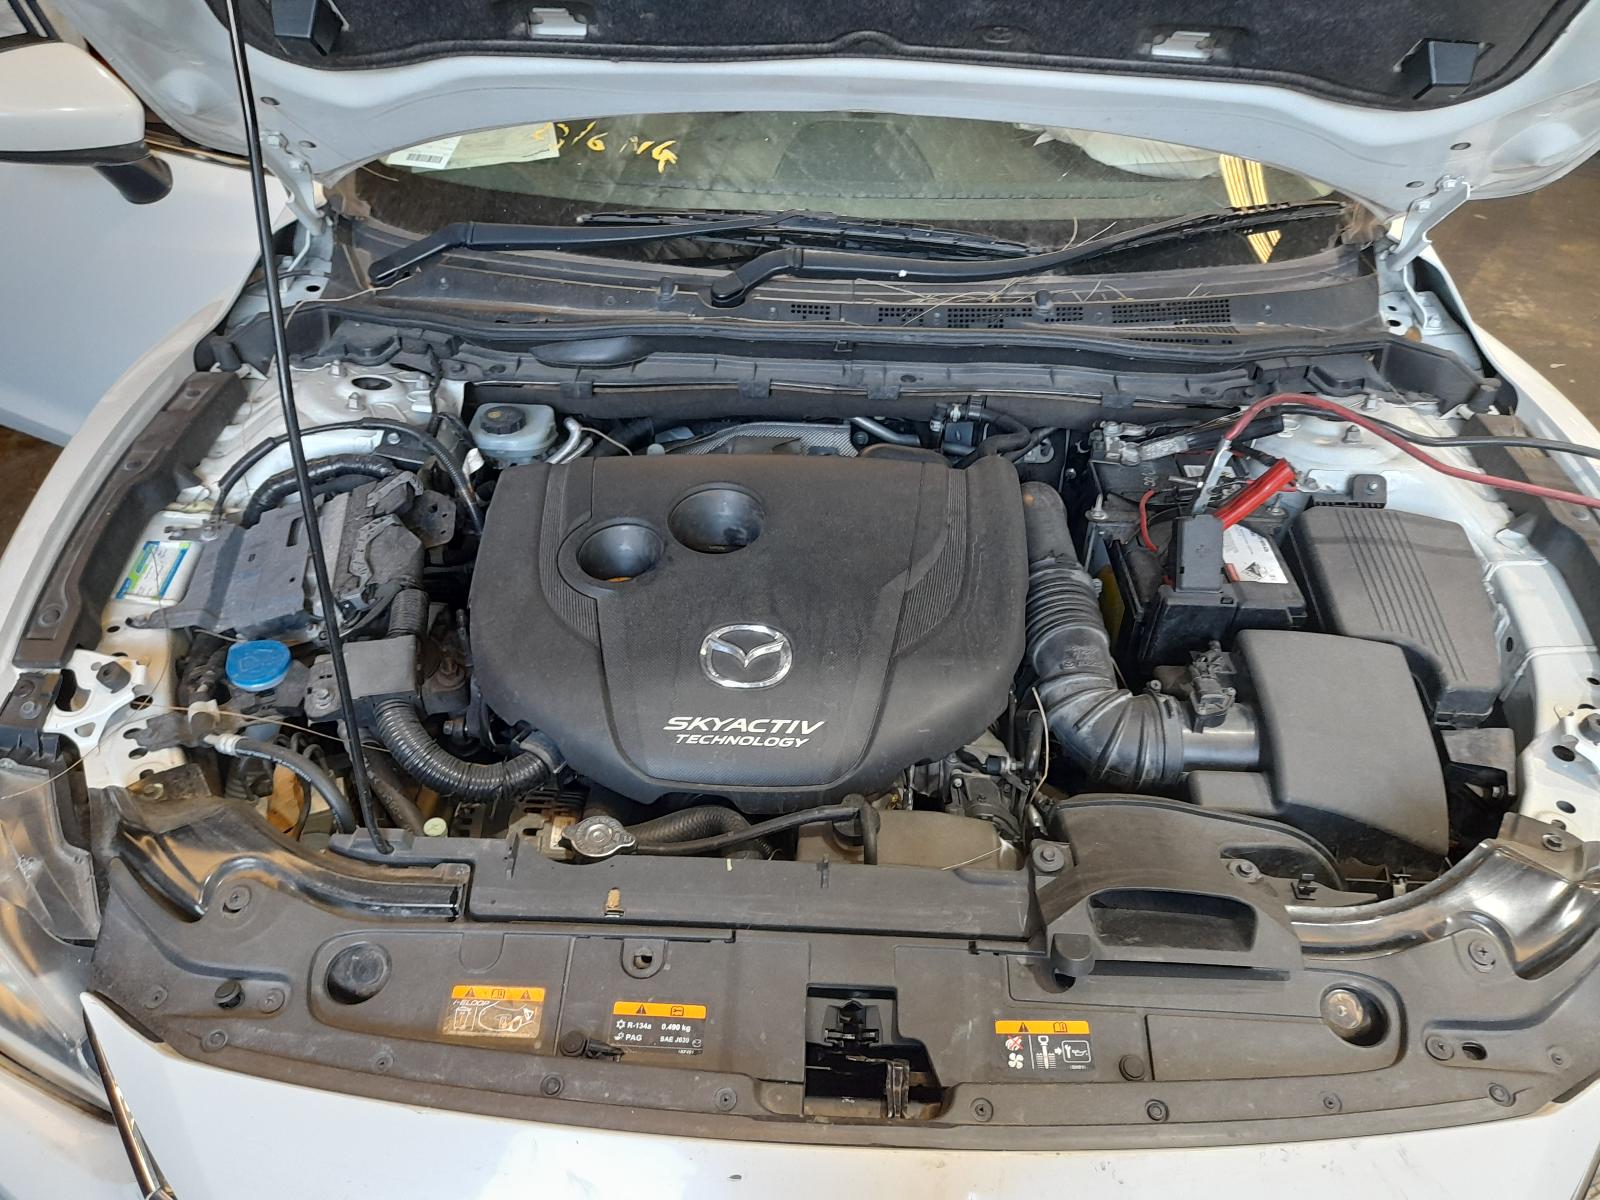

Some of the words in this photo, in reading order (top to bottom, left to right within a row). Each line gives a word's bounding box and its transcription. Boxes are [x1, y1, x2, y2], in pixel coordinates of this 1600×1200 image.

[663, 716, 825, 734] SKYACTIV
[676, 734, 809, 748] TECHNOLOGY
[627, 1021, 651, 1029] R-134a
[681, 1023, 691, 1032] kg
[625, 1033, 642, 1041] PAG
